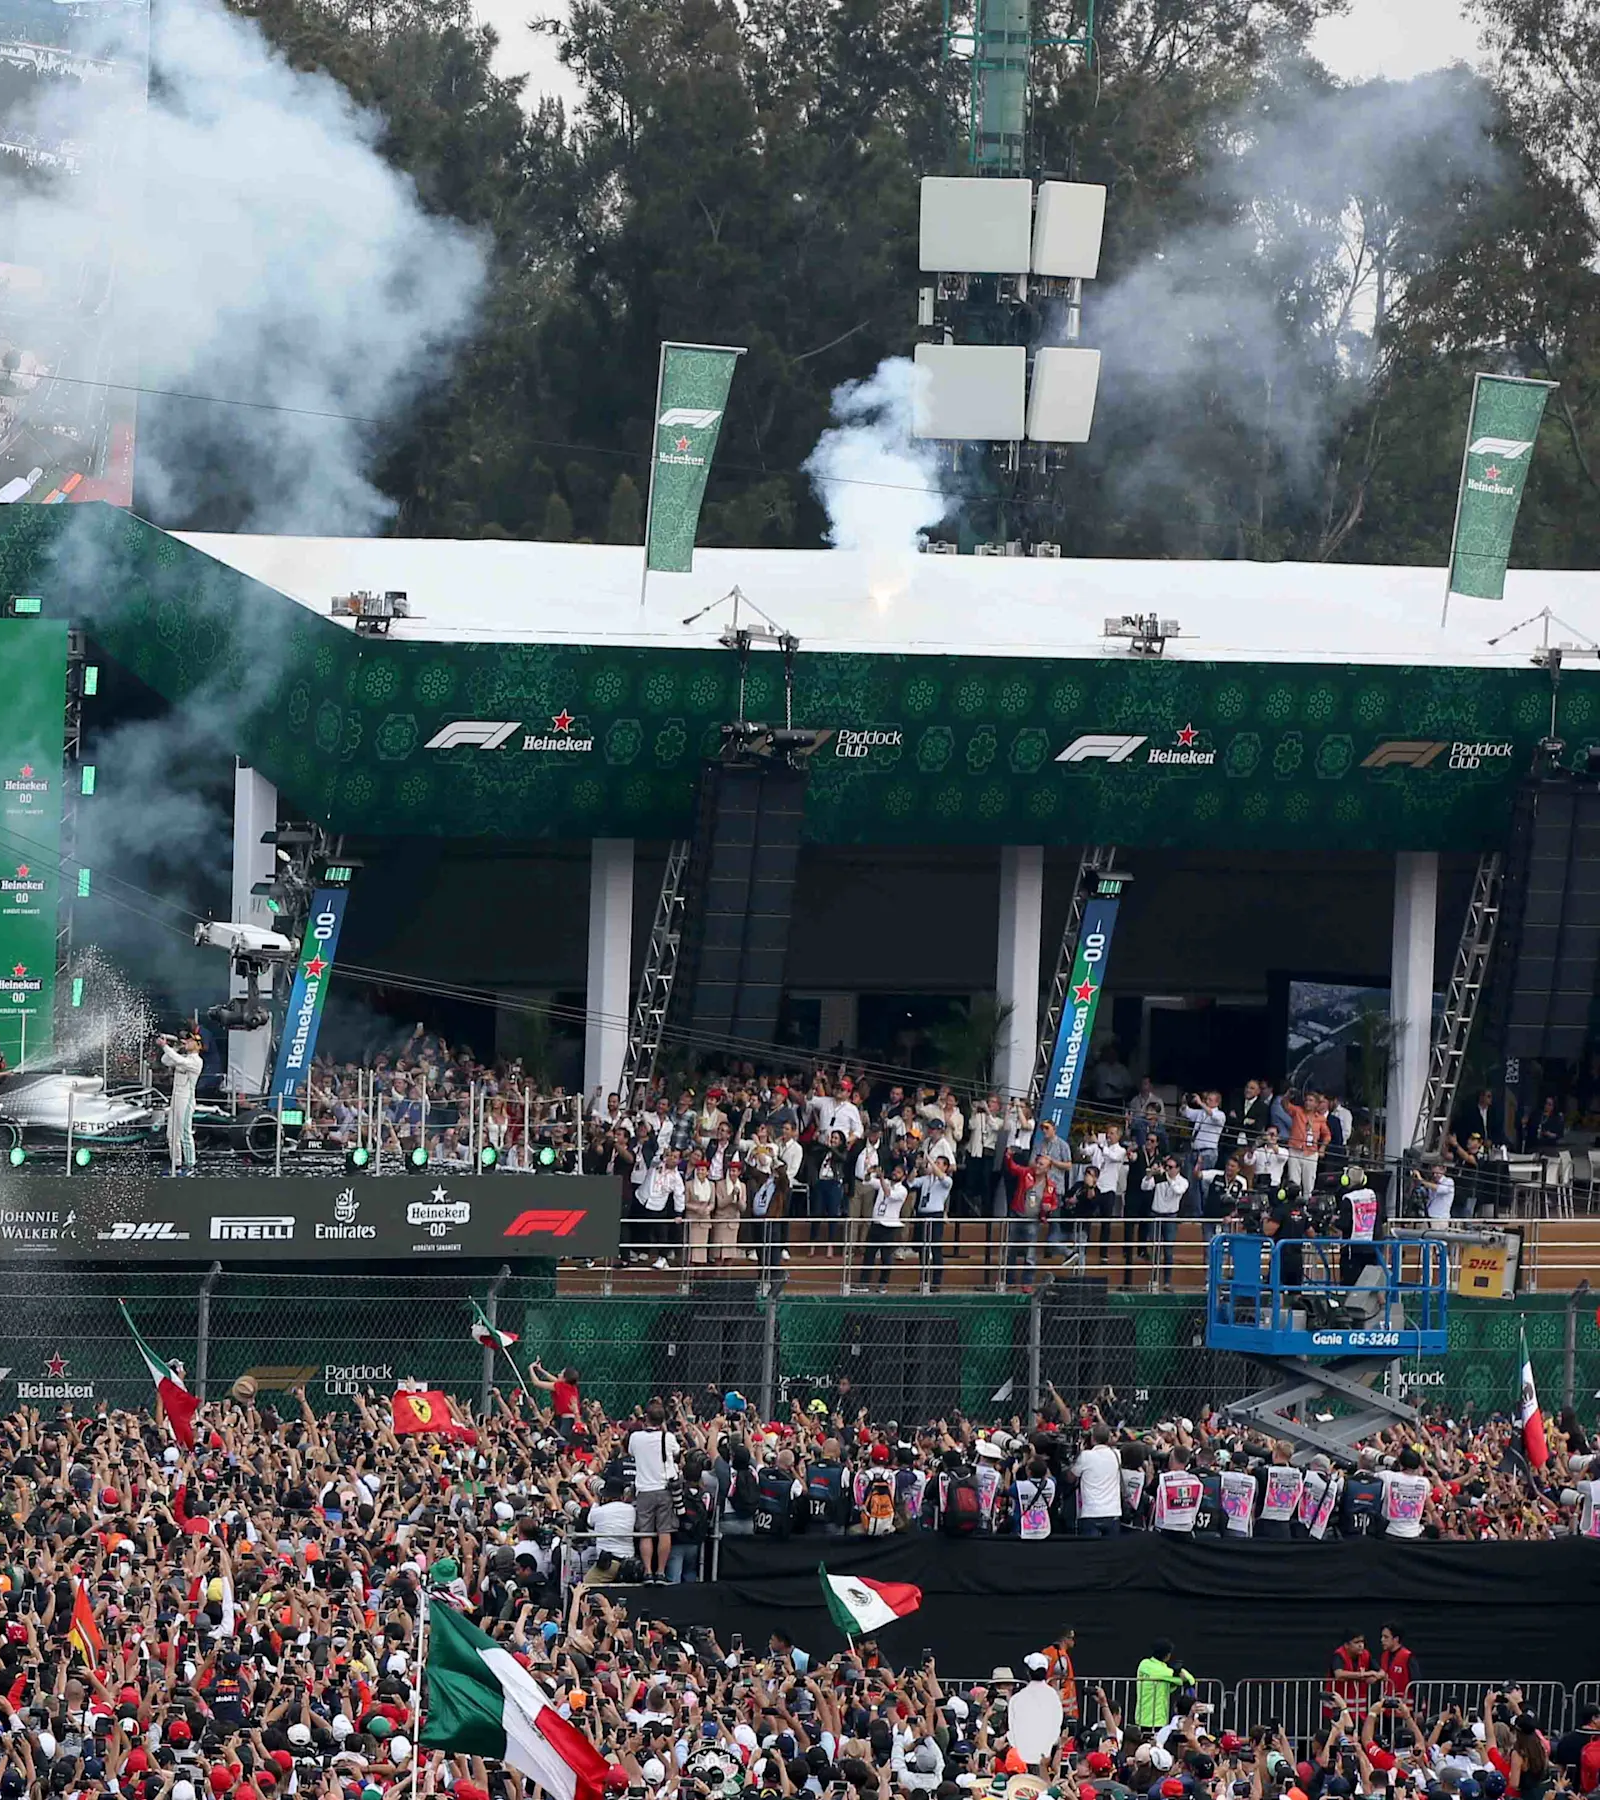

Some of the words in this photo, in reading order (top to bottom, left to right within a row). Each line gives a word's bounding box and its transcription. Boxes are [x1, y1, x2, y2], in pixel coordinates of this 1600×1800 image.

[1468, 478, 1514, 495] Heineken
[522, 735, 593, 752] Heineken
[837, 729, 902, 745] Paddock
[835, 742, 868, 758] Club
[1147, 748, 1215, 765] Heineken
[1450, 742, 1513, 758] Paddock
[1448, 754, 1480, 770] Club
[5, 781, 47, 791] Heineken
[1, 880, 44, 890] Heineken
[314, 912, 336, 940] 0.0
[1083, 933, 1106, 962] 0.0
[286, 980, 319, 1069] Heineken
[1054, 1005, 1088, 1099] Heineken
[412, 1206, 465, 1219] Heineken
[1, 1225, 58, 1239] WALKER
[108, 1222, 178, 1240] DHL
[210, 1215, 296, 1240] PIRELLI
[315, 1222, 376, 1240] Emirates
[1469, 1258, 1499, 1270] DHL
[1312, 1332, 1342, 1345] Genie
[1349, 1332, 1399, 1346] GS-3246
[325, 1364, 392, 1380] Paddock
[17, 1381, 93, 1399] Heineken
[324, 1378, 359, 1395] Club
